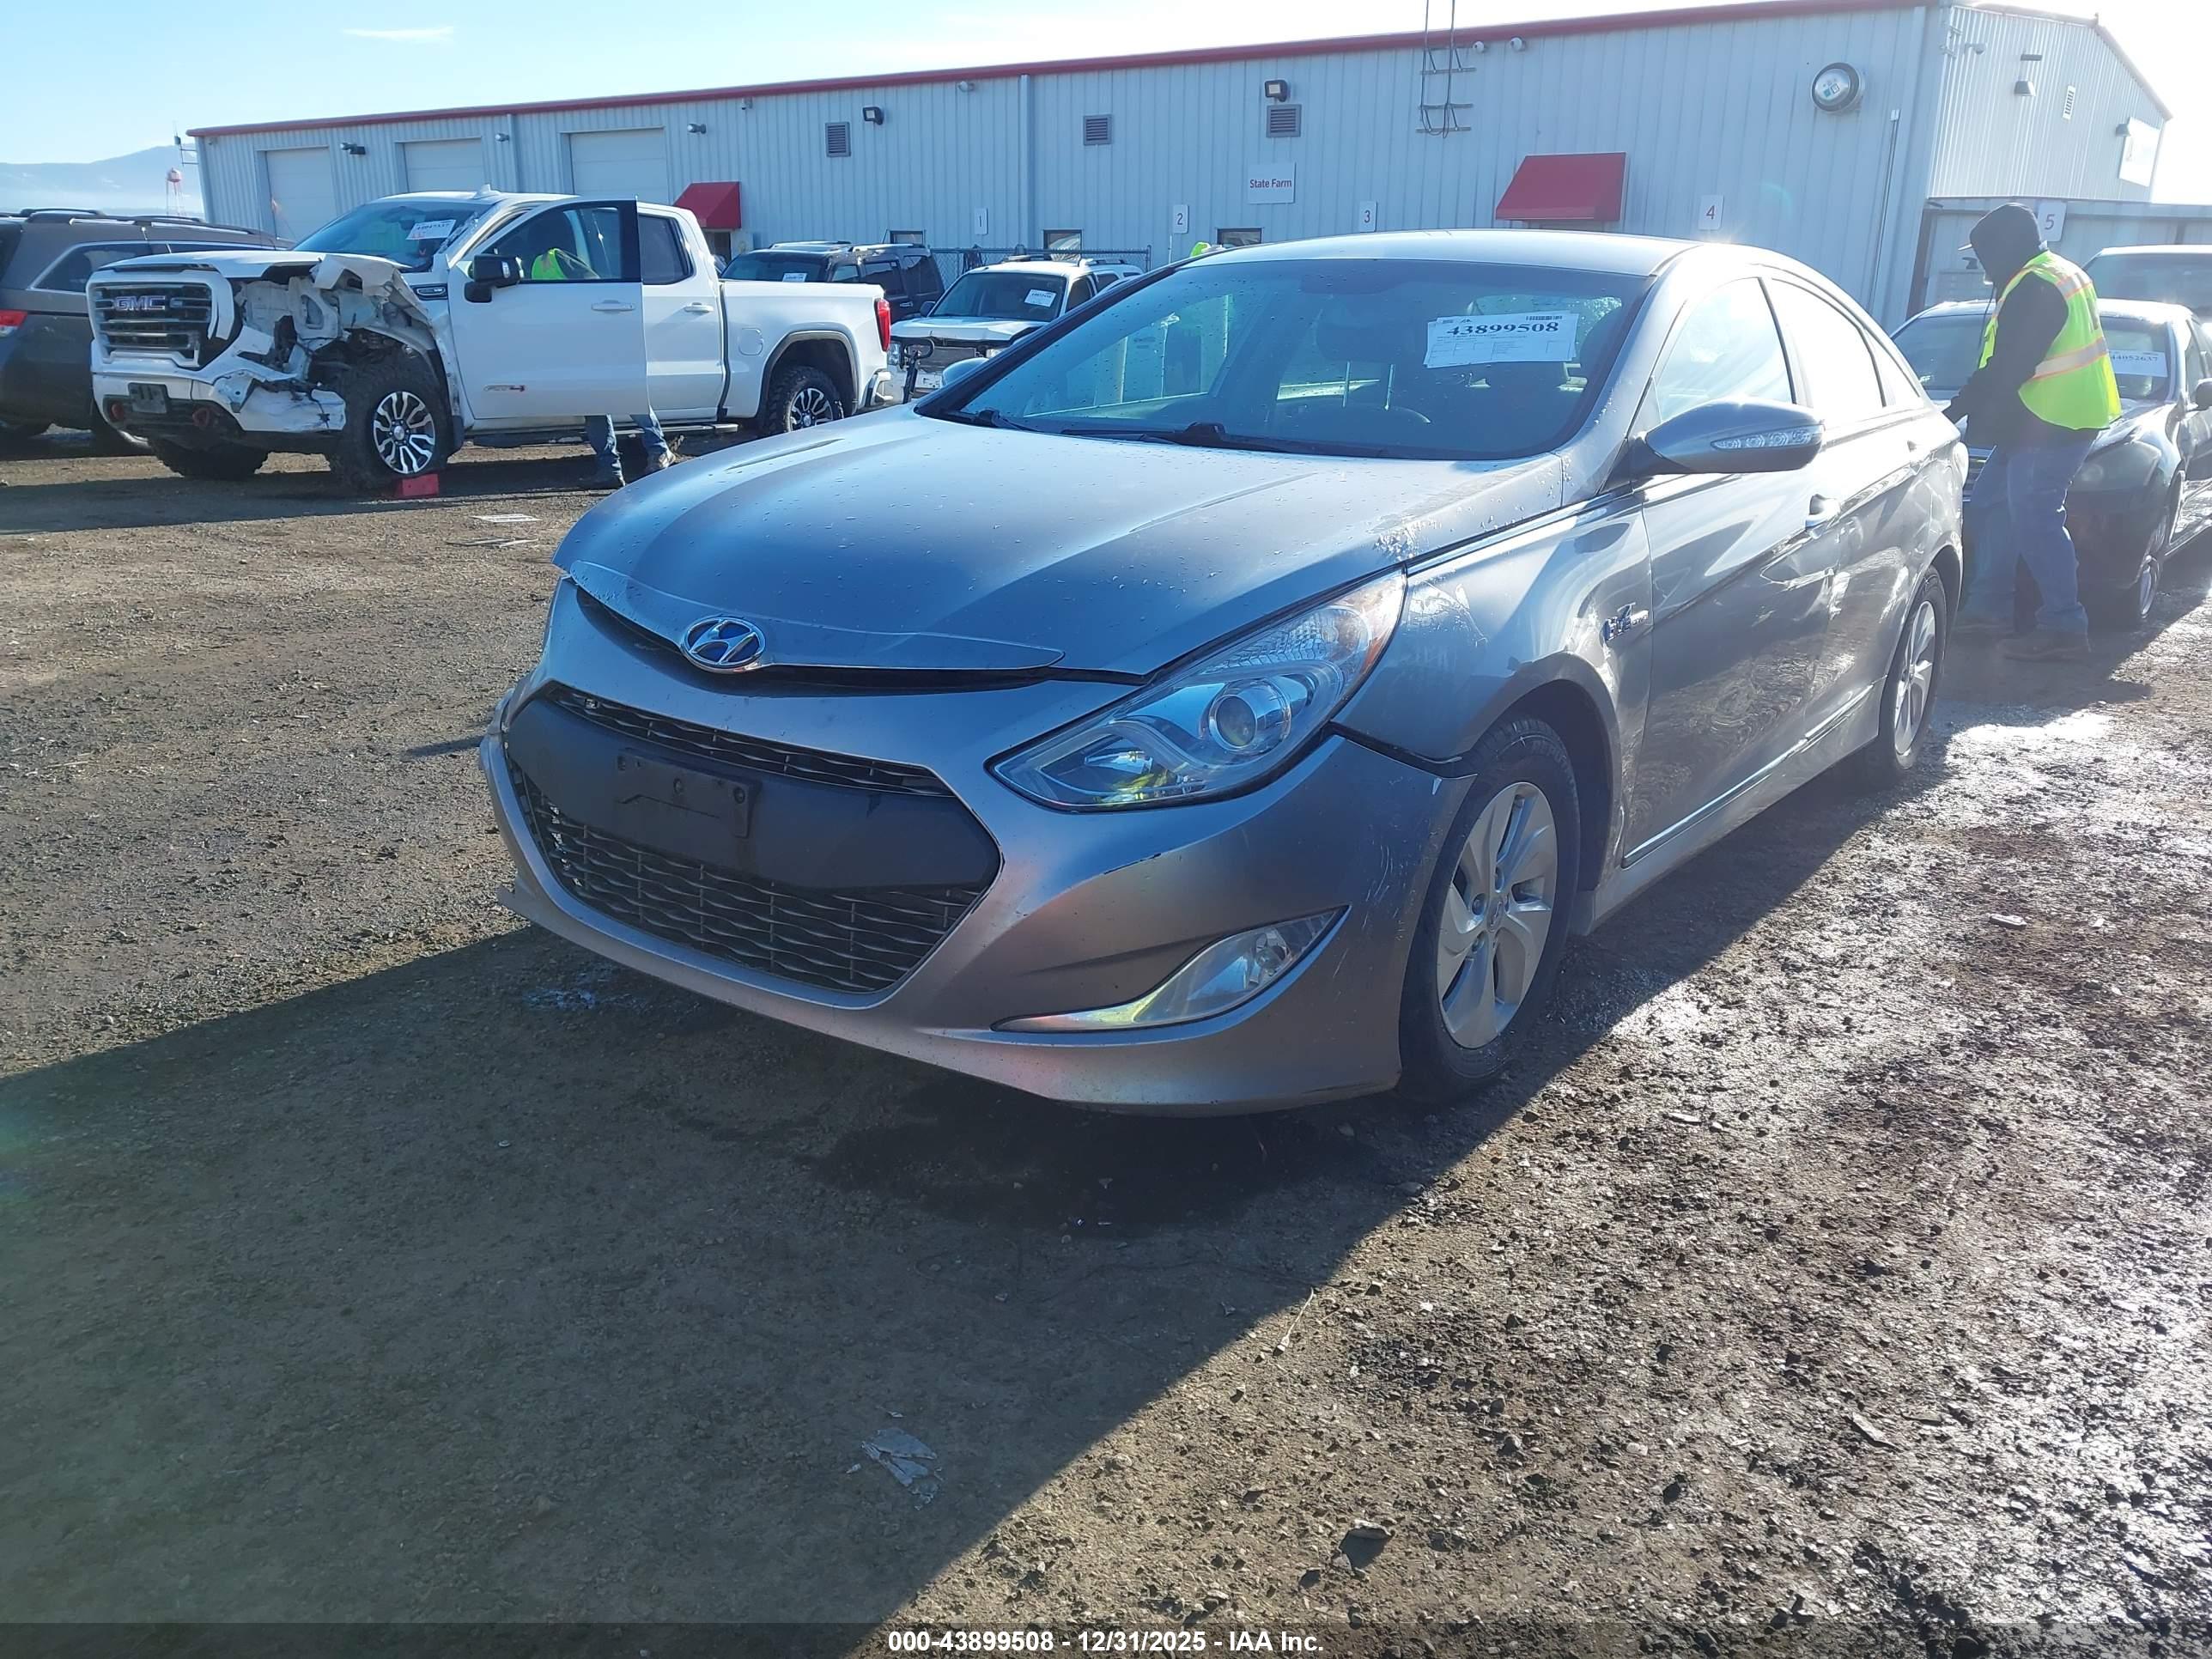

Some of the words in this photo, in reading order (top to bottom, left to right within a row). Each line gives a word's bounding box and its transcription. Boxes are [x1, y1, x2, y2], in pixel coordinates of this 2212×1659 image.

[1249, 179, 1270, 189] State
[1271, 178, 1292, 188] Farm
[1176, 212, 1183, 226] 2
[1364, 210, 1370, 223] 3
[1705, 205, 1715, 220] 4
[2045, 214, 2056, 230] 5
[115, 295, 166, 311] GMC
[1446, 321, 1559, 336] 43899508
